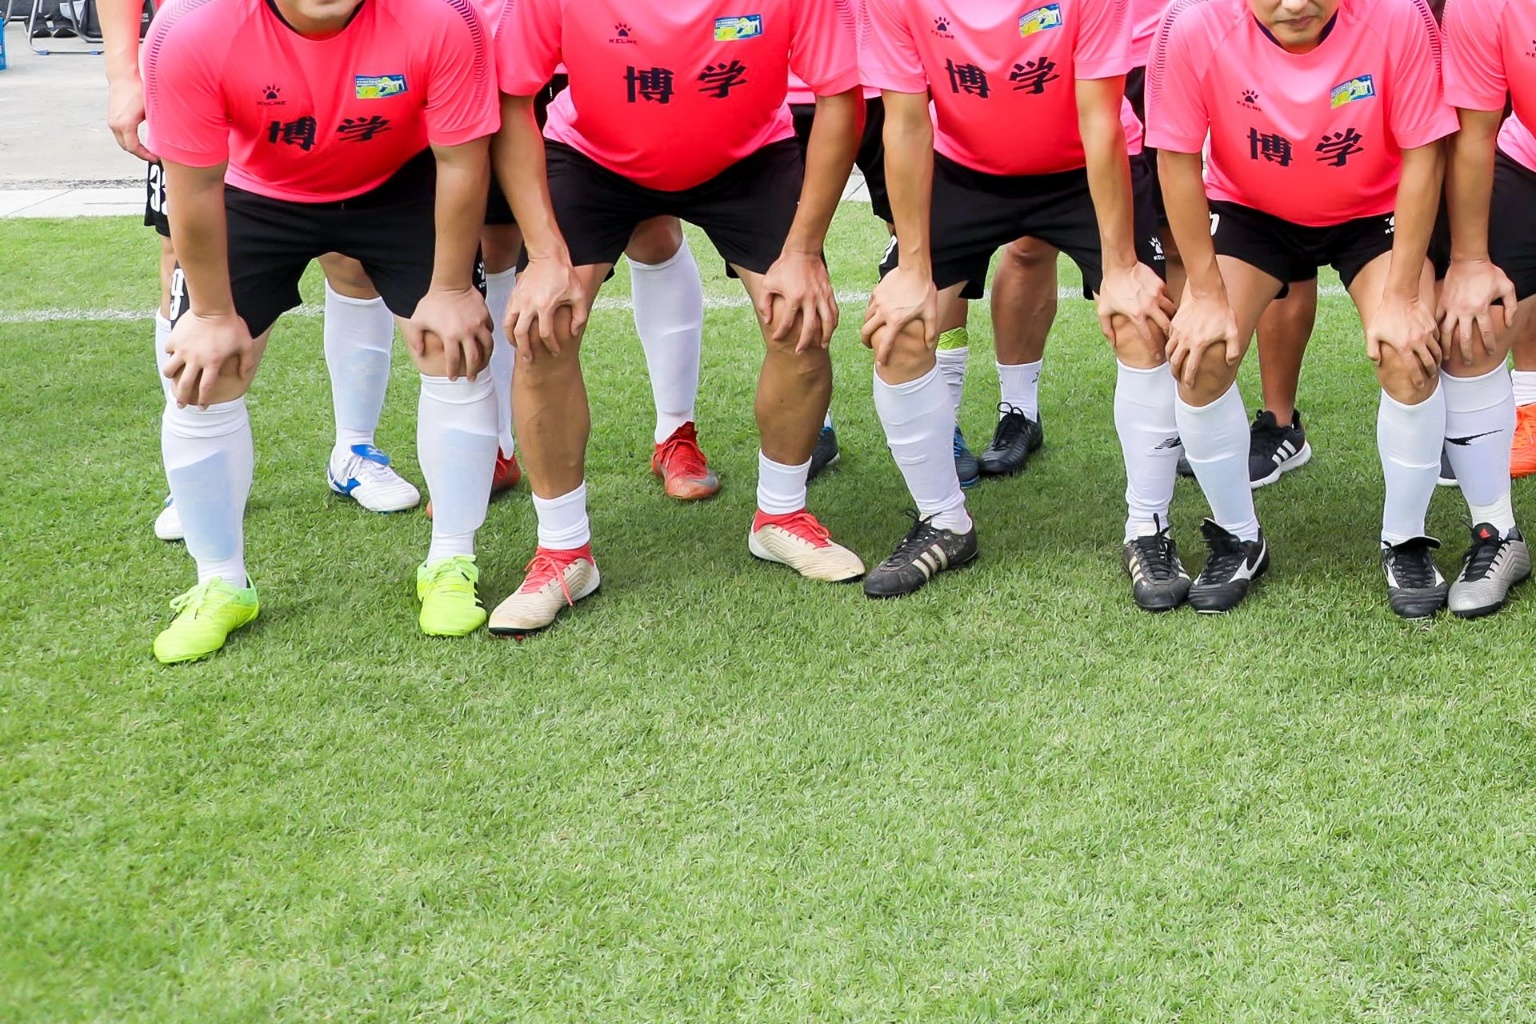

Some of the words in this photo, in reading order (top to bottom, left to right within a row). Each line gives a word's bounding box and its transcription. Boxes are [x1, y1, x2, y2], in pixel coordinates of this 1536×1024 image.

[624, 59, 747, 104] 博学
[945, 56, 1059, 99] 博学
[267, 115, 391, 151] 博学
[1247, 127, 1363, 168] 博学
